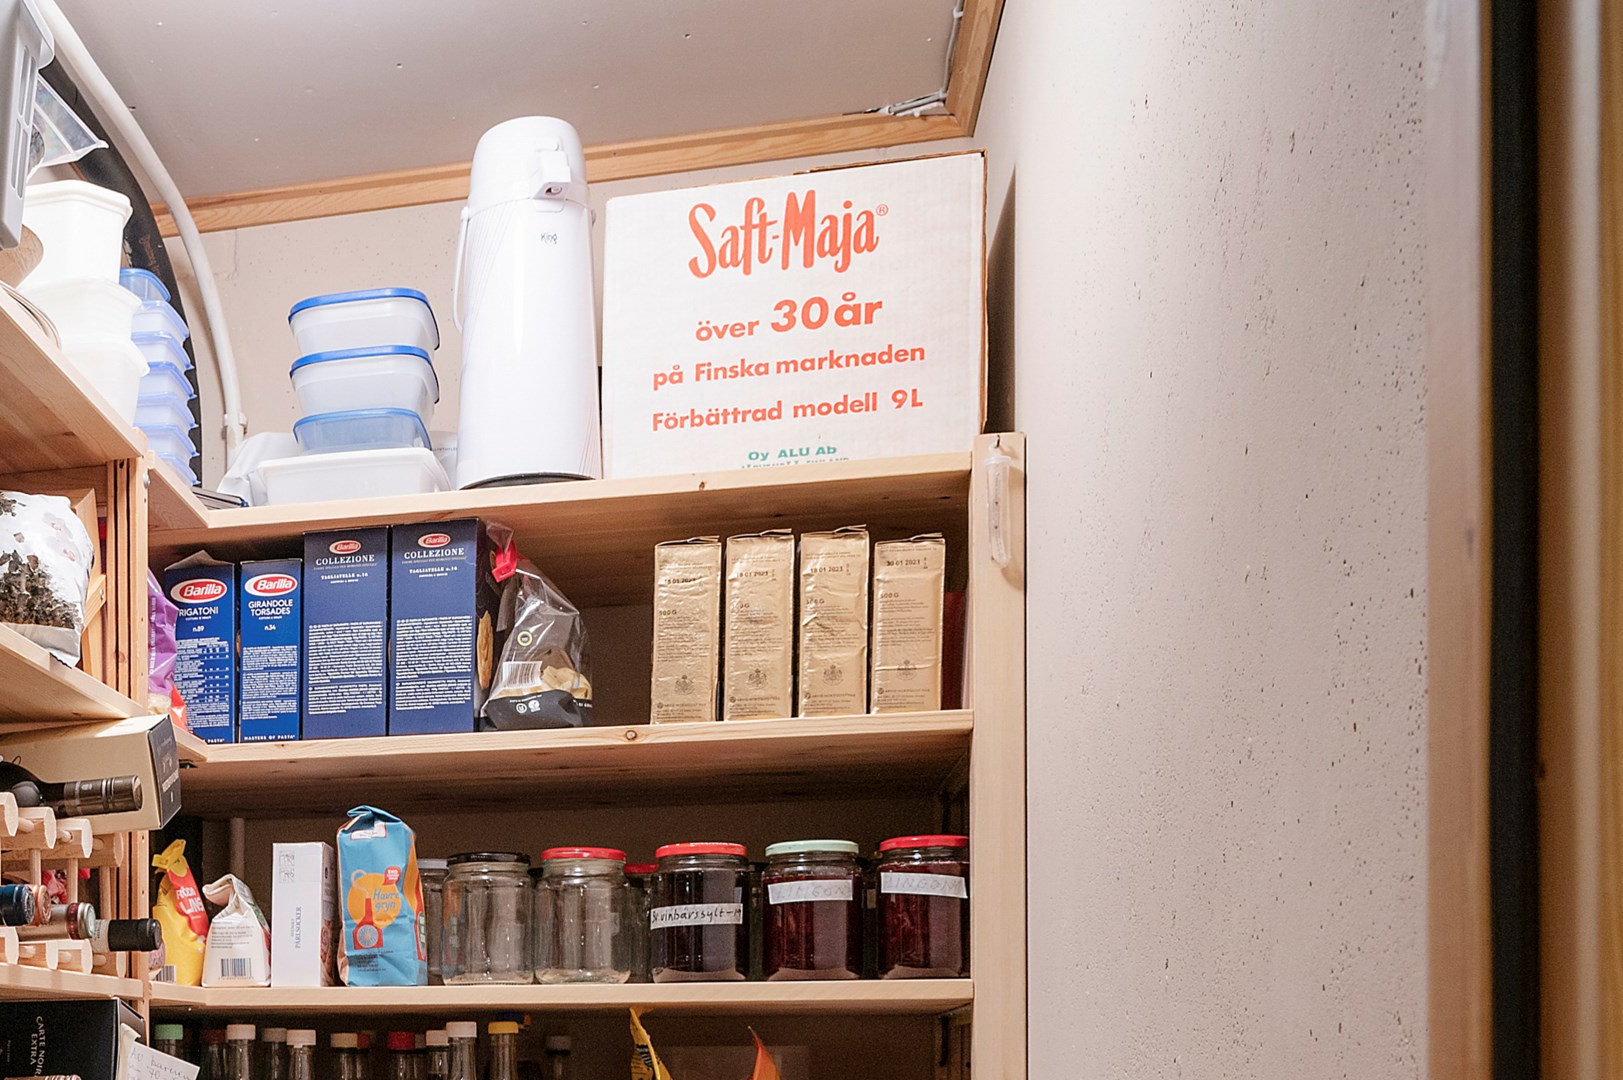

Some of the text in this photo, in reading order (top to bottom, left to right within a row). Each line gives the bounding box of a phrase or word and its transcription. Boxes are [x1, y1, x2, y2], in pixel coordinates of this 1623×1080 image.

[688, 189, 879, 278] Saft-Maja
[695, 291, 883, 341] över 30 år
[653, 343, 925, 391] på Finska marknaden
[652, 391, 878, 431] Förbättrad modell
[747, 445, 837, 462] Oy ALU Ab
[425, 535, 448, 544] Barilla
[336, 542, 359, 551] Barilla
[315, 553, 376, 567] COLLEZIONE
[404, 547, 465, 560] COLLEZIONE
[321, 573, 356, 581] TAGLIATELLE
[183, 584, 222, 597] Barilla
[256, 578, 293, 591] Barilla
[248, 599, 294, 609] GIRANDOLE
[179, 606, 219, 616] RIGATONI
[251, 607, 291, 616] TORSADES
[373, 888, 400, 900] Havre
[375, 899, 396, 913] gryn
[34, 1016, 45, 1077] CARTE NOIR
